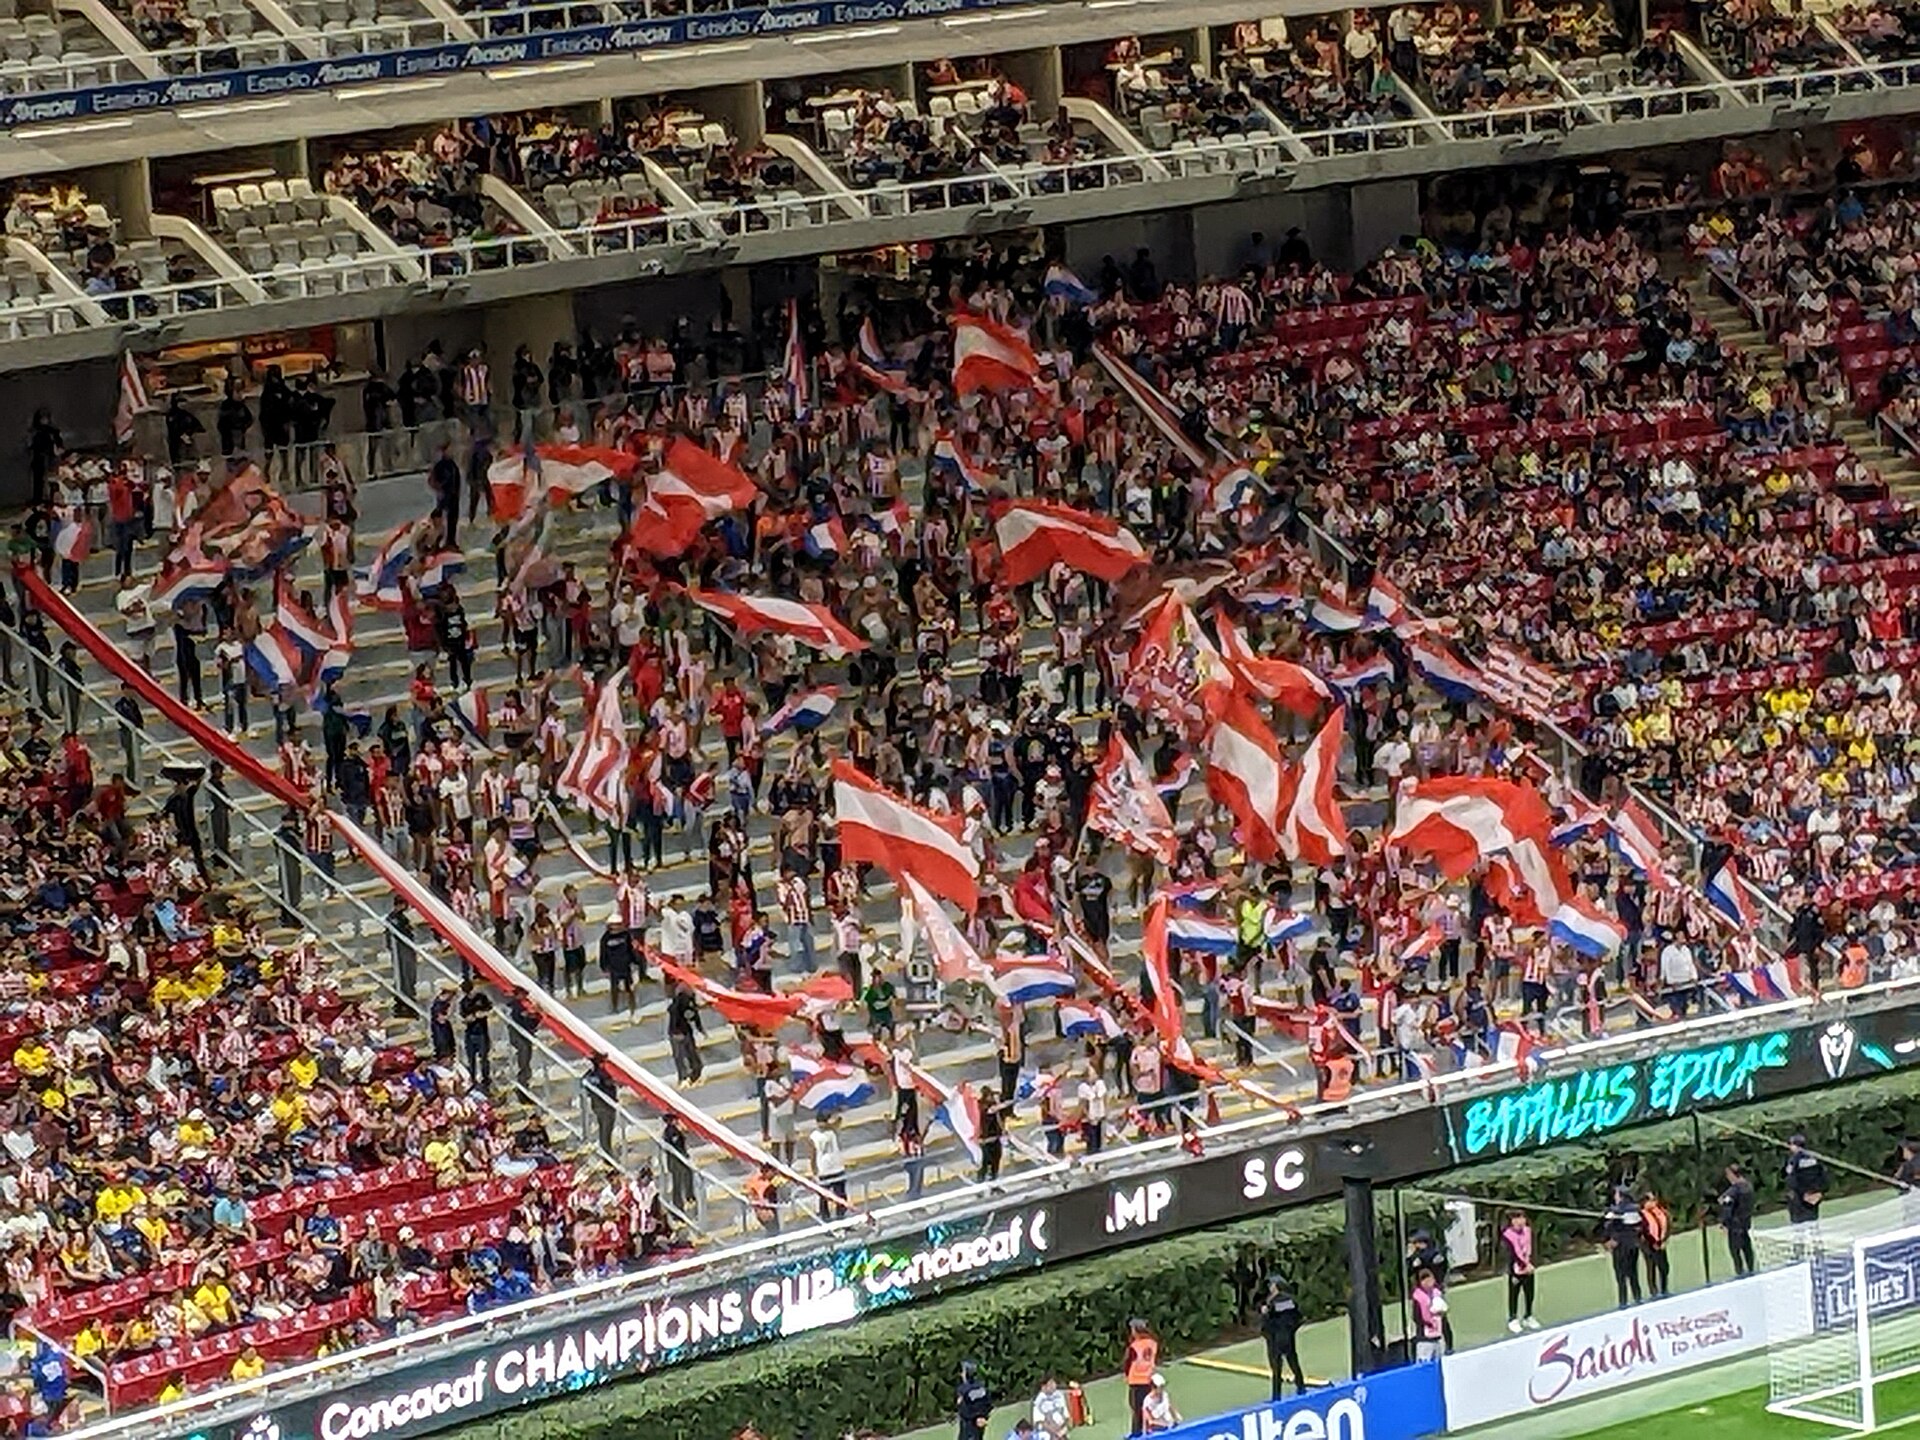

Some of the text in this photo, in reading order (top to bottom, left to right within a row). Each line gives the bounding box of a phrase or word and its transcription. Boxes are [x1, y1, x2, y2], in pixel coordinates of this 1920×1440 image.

[687, 16, 750, 39] Estadio
[864, 1215, 1023, 1295] Concacaf
[1105, 1181, 1172, 1233] MP
[320, 1267, 836, 1440] Concacaf CHAMPIONS CUP
[1529, 1316, 1657, 1404] Saudi
